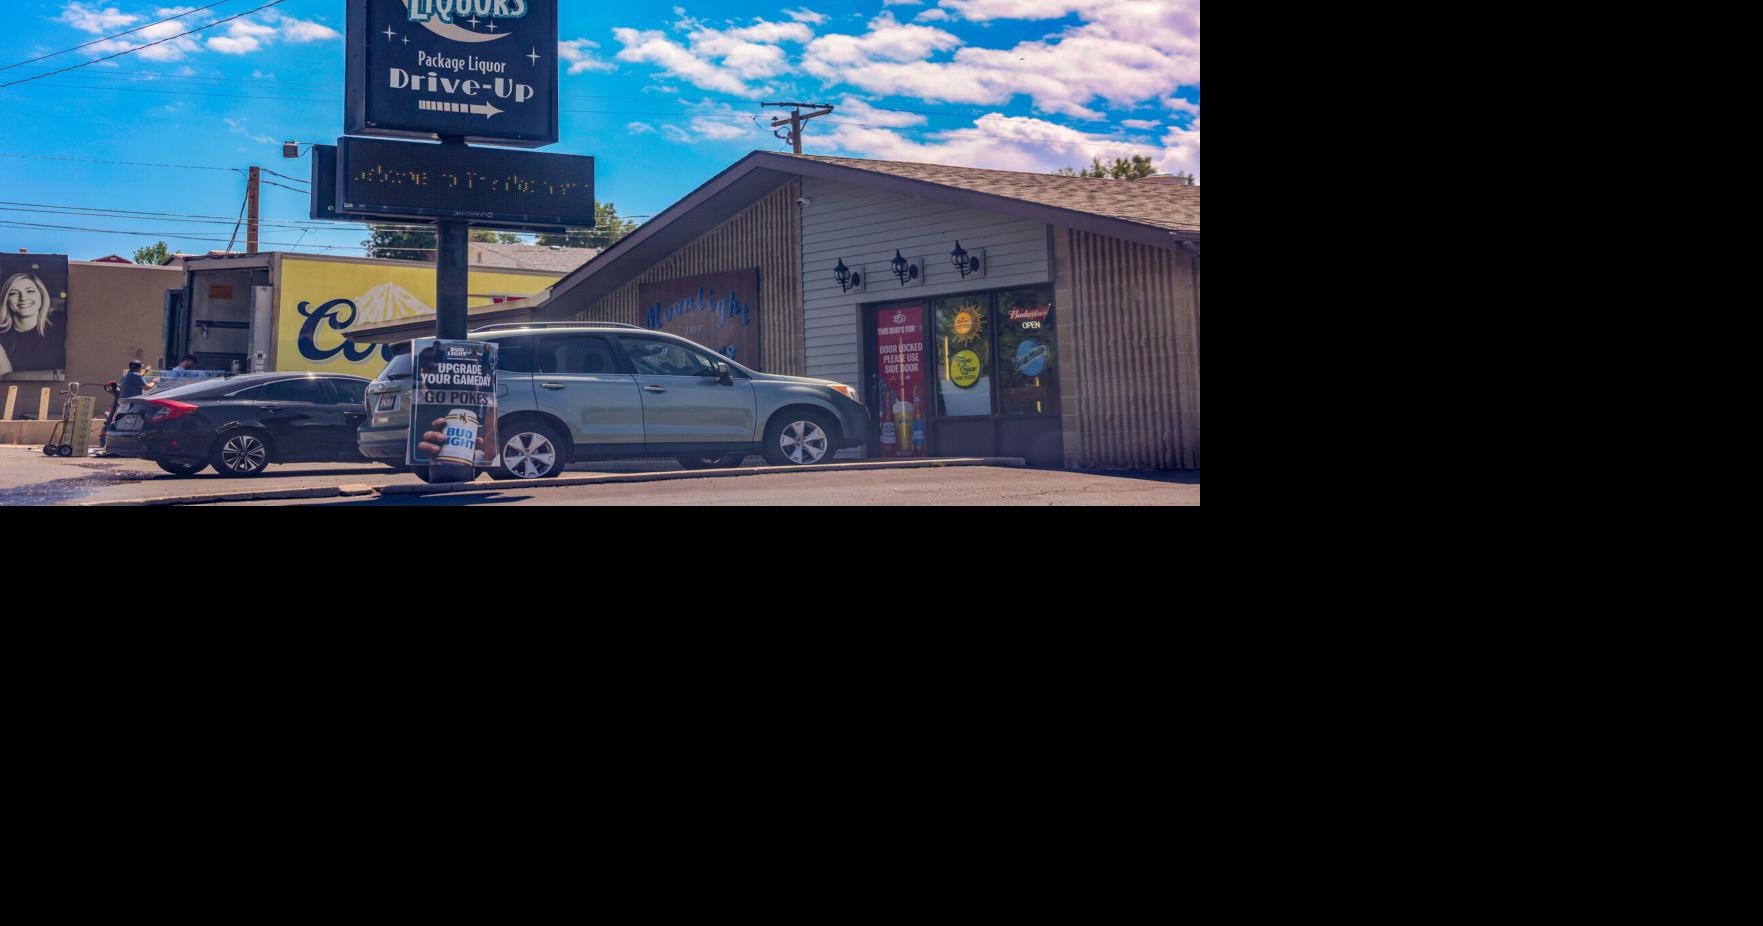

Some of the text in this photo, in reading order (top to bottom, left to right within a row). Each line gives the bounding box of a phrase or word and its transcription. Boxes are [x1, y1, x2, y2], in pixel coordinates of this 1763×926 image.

[418, 51, 507, 75] Package Liquor
[389, 67, 534, 103] Drive-Up
[1022, 321, 1041, 329] OPEN
[880, 342, 923, 354] DOOR LOCKED
[883, 353, 920, 364] PLEASE USE
[438, 362, 482, 375] UPGRADE
[884, 362, 919, 374] SIDE DOOR
[421, 373, 492, 387] YOUR GAMEDAY
[424, 391, 488, 405] GO POKES
[446, 427, 473, 439] BUD
[445, 436, 474, 449] IGHT
